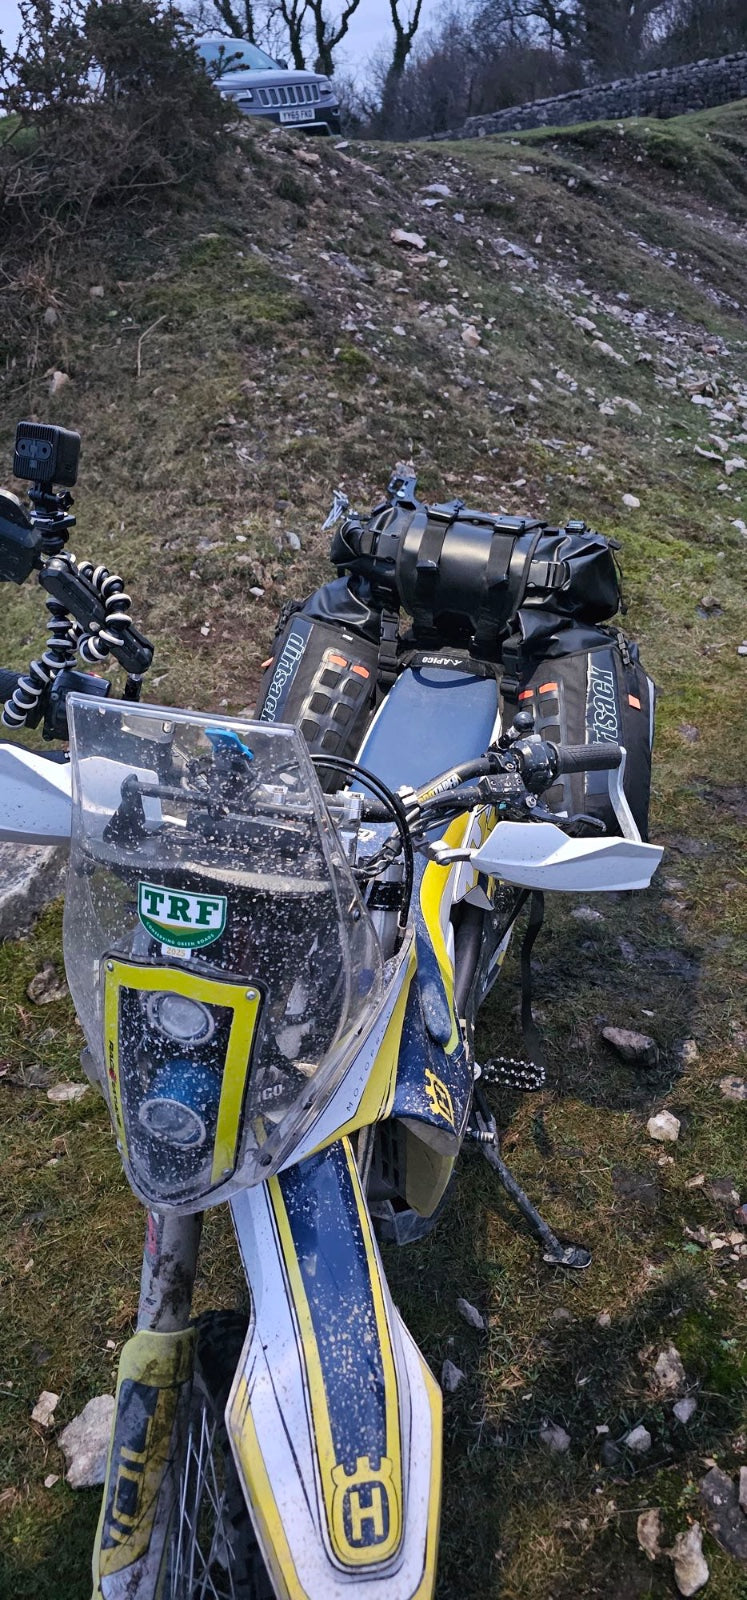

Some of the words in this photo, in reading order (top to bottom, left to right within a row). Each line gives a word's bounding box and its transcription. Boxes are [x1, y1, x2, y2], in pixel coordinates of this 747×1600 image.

[260, 632, 305, 723] dirtsack
[589, 665, 619, 746] rtsack
[144, 889, 220, 926] TRF
[166, 947, 187, 957] 2025
